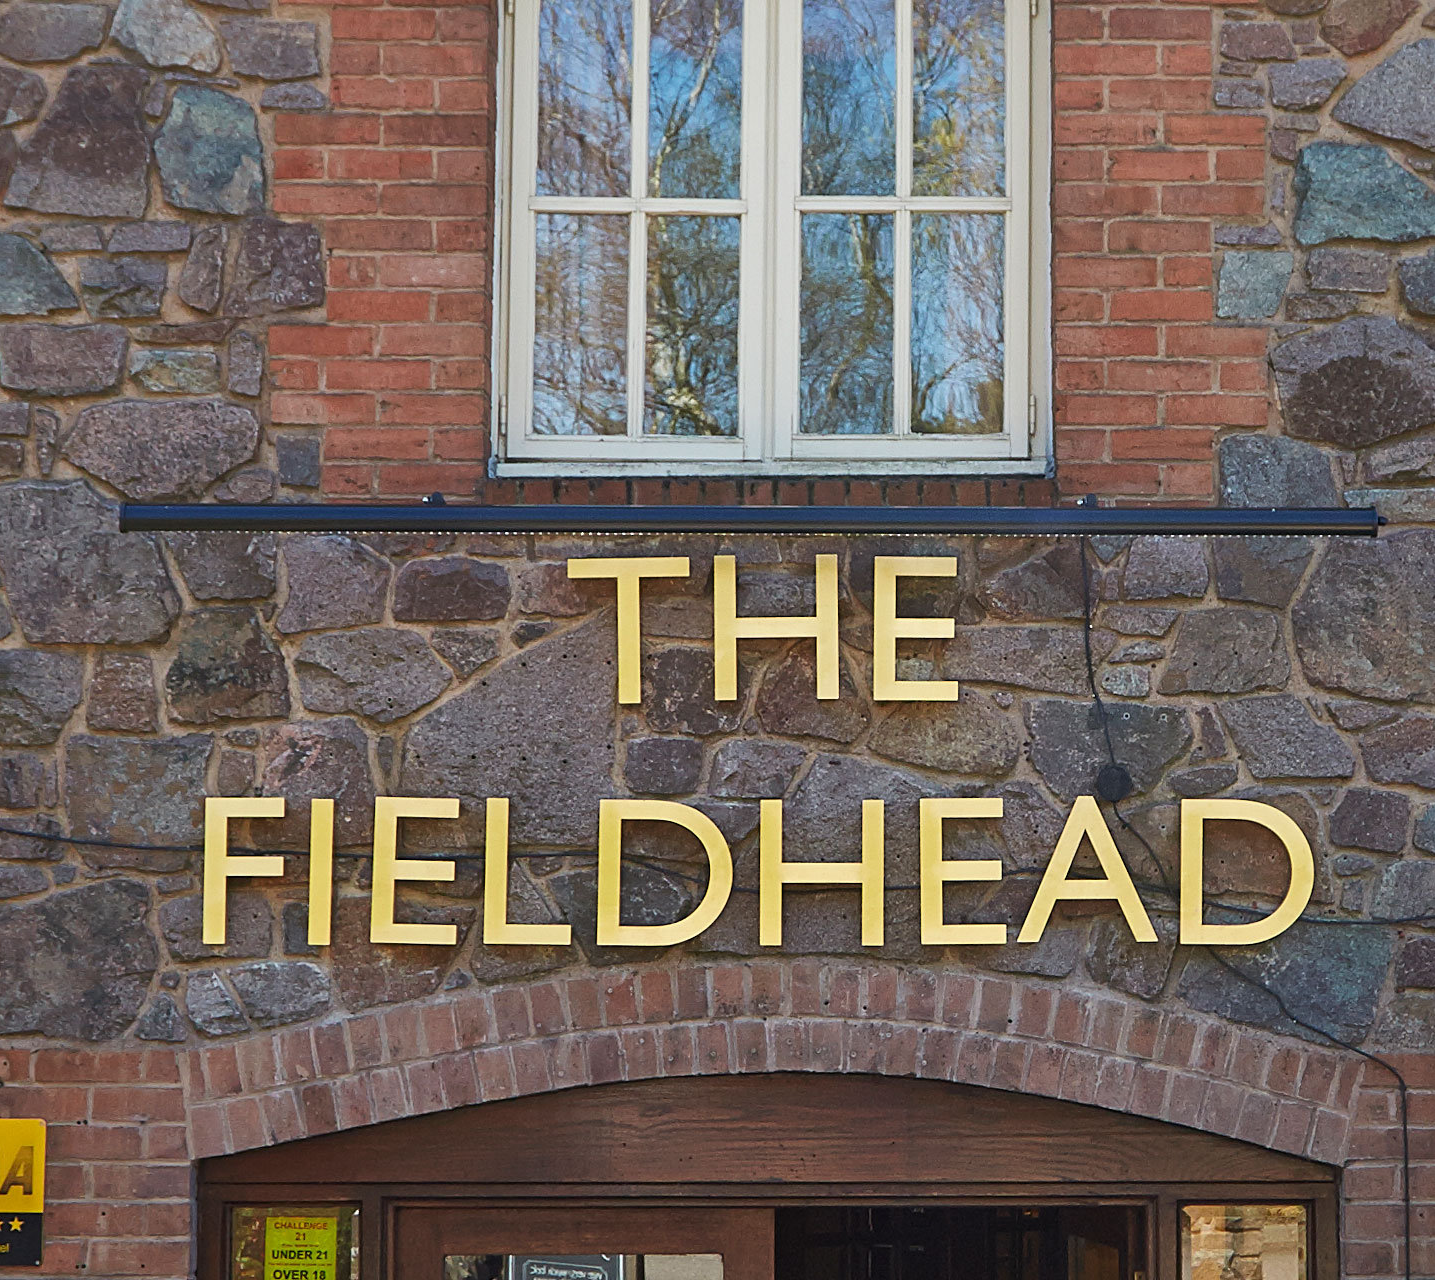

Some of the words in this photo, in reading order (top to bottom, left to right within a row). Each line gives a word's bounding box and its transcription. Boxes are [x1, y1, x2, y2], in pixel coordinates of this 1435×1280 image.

[567, 553, 959, 704] THE
[202, 795, 1315, 947] FIELDHEAD
[274, 1222, 328, 1230] CHALLENGE
[295, 1232, 306, 1240] 21
[272, 1250, 313, 1260] UNDER
[316, 1250, 328, 1260] 21
[273, 1269, 308, 1280] OVER
[313, 1270, 326, 1280] 18
